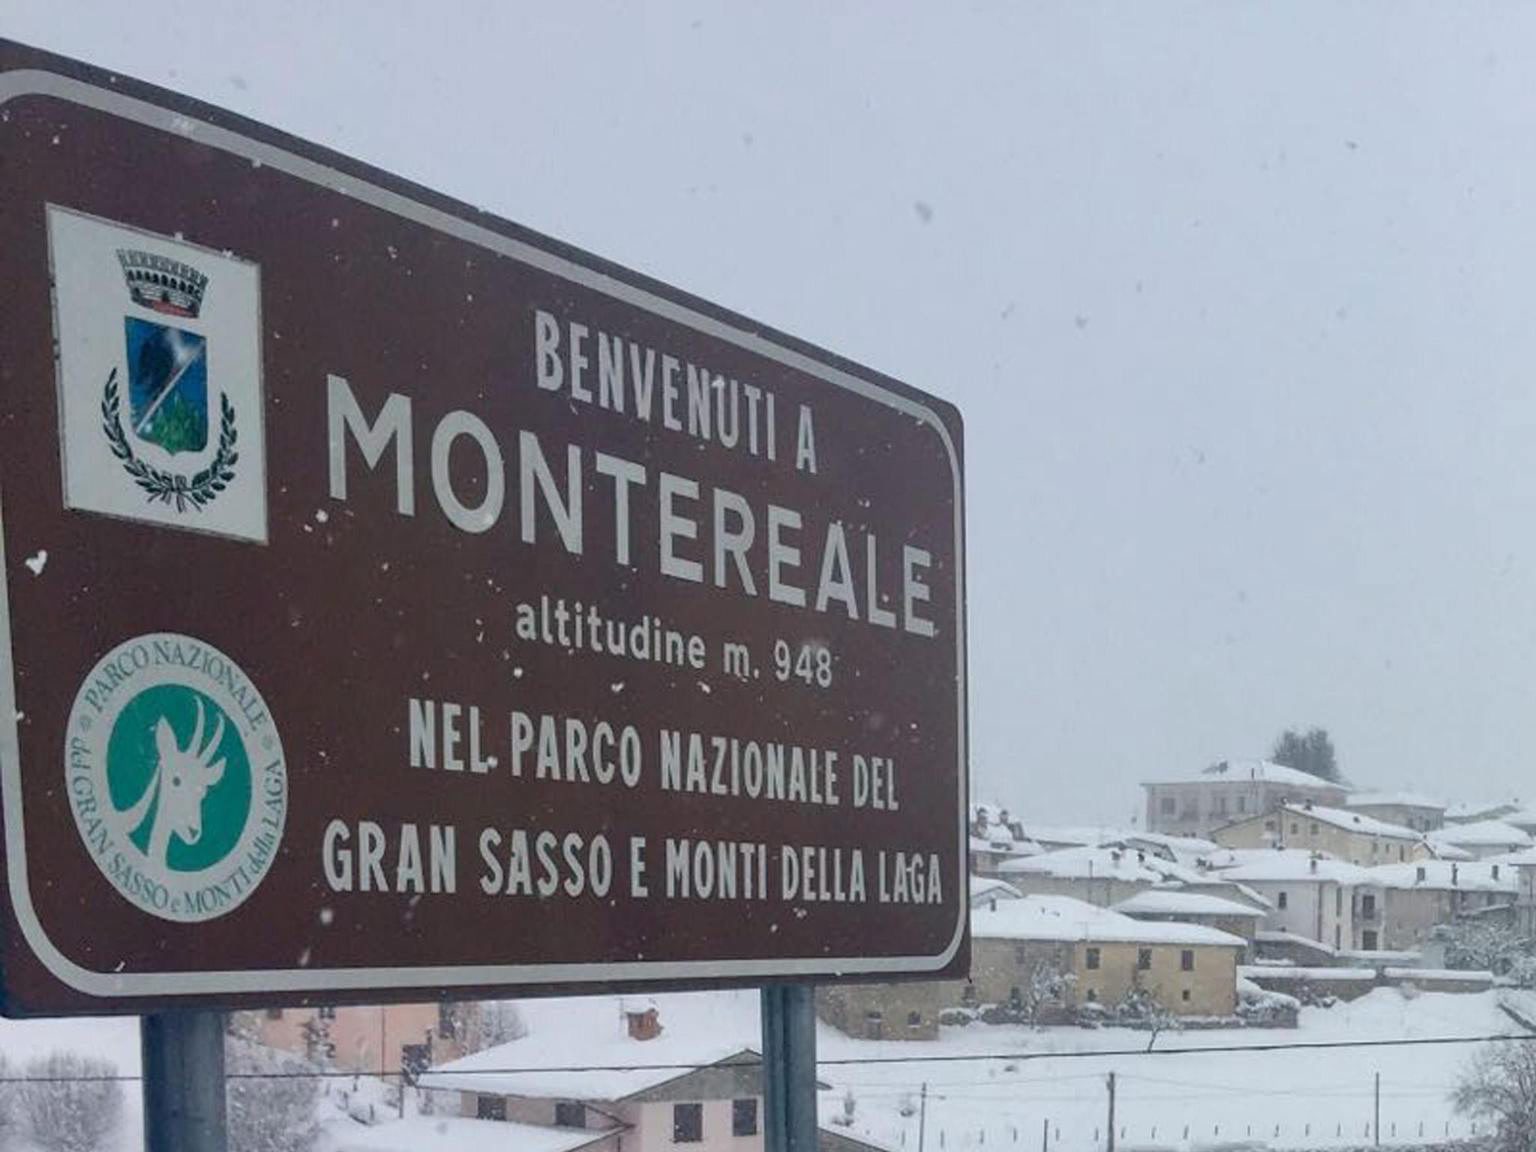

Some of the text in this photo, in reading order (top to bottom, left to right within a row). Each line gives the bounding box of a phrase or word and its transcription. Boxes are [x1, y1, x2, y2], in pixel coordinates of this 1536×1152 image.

[535, 310, 817, 474] BENVENUTI A
[327, 374, 935, 637] MONTEREALE
[85, 640, 268, 732] PARCO NAZIONALE
[516, 598, 832, 687] altitudine m. 948
[408, 699, 899, 811] NEL PARCO NAZIONALE DEL
[73, 775, 113, 855] GRAN
[109, 854, 168, 909] SASSO
[185, 873, 250, 913] MONTI
[250, 832, 275, 876] della
[264, 758, 283, 830] LAGA
[323, 820, 942, 905] GRAN SASSO E MONTI DELLA LAGA
